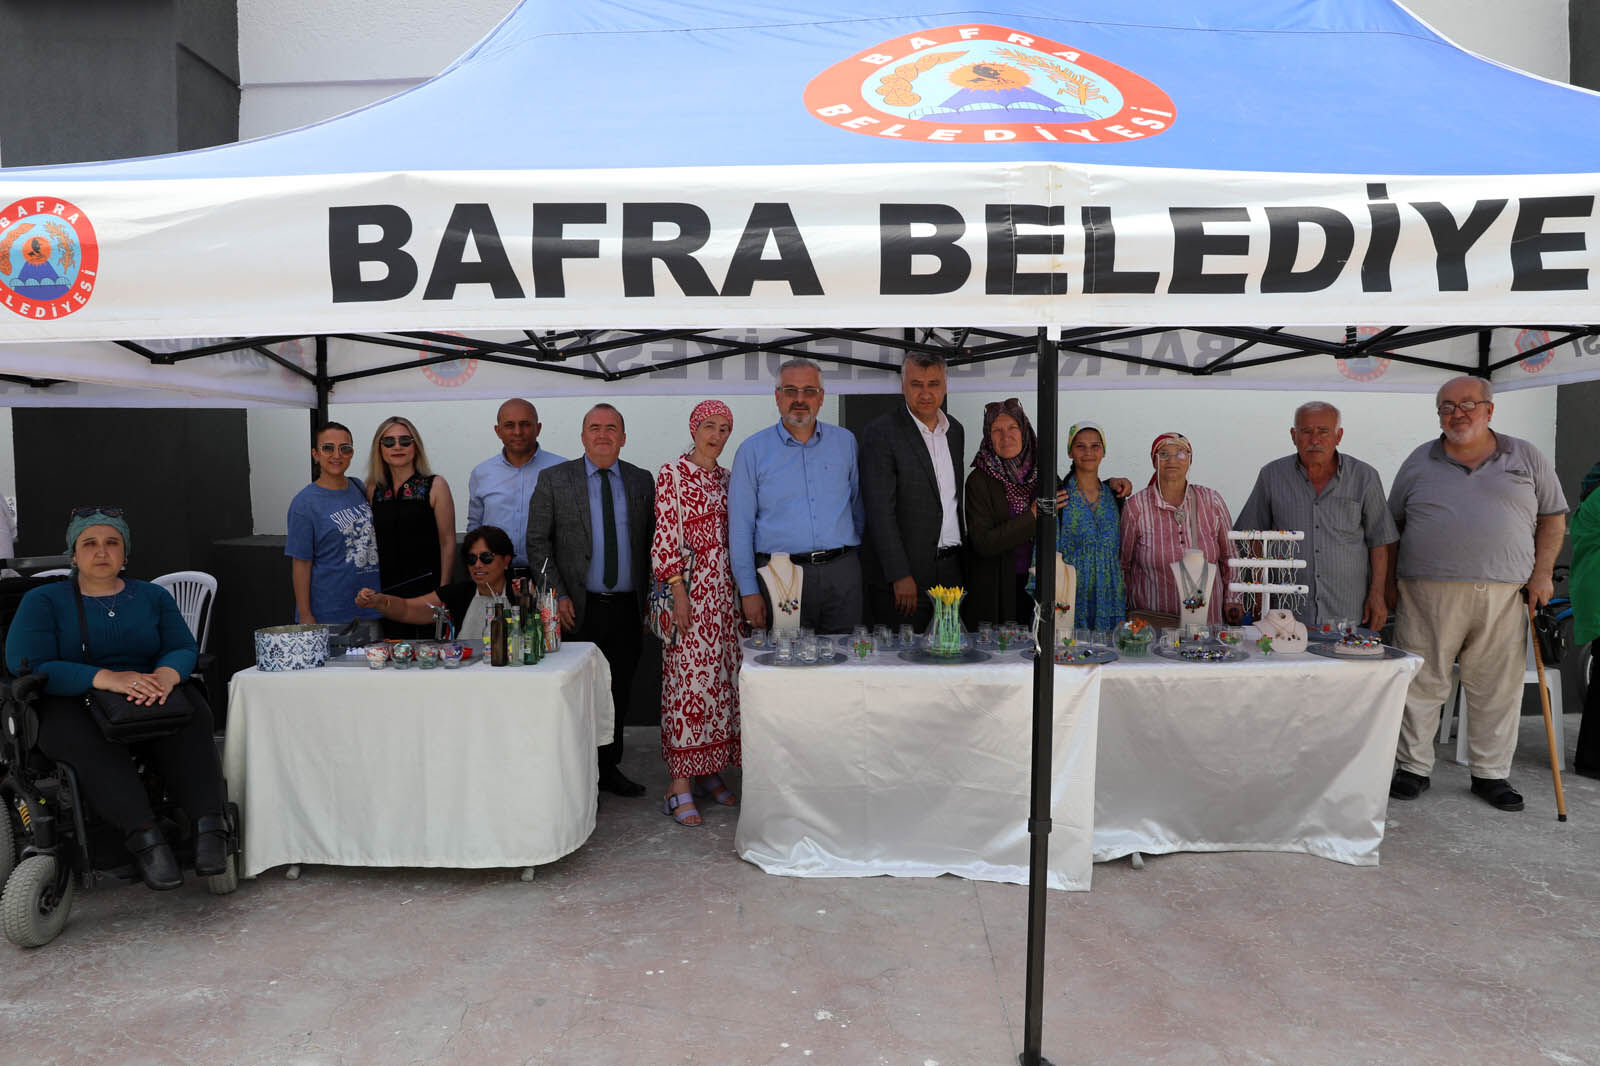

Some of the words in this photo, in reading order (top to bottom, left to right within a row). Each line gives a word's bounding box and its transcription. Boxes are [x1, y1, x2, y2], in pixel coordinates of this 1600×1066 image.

[859, 28, 1081, 66] BAFRA
[815, 103, 1173, 142] BELEDİYESİ
[0, 201, 79, 228] BAFRA
[329, 202, 825, 303] BAFRA
[880, 183, 1595, 295] BELEDİYE
[0, 268, 96, 318] LEDİYESİ
